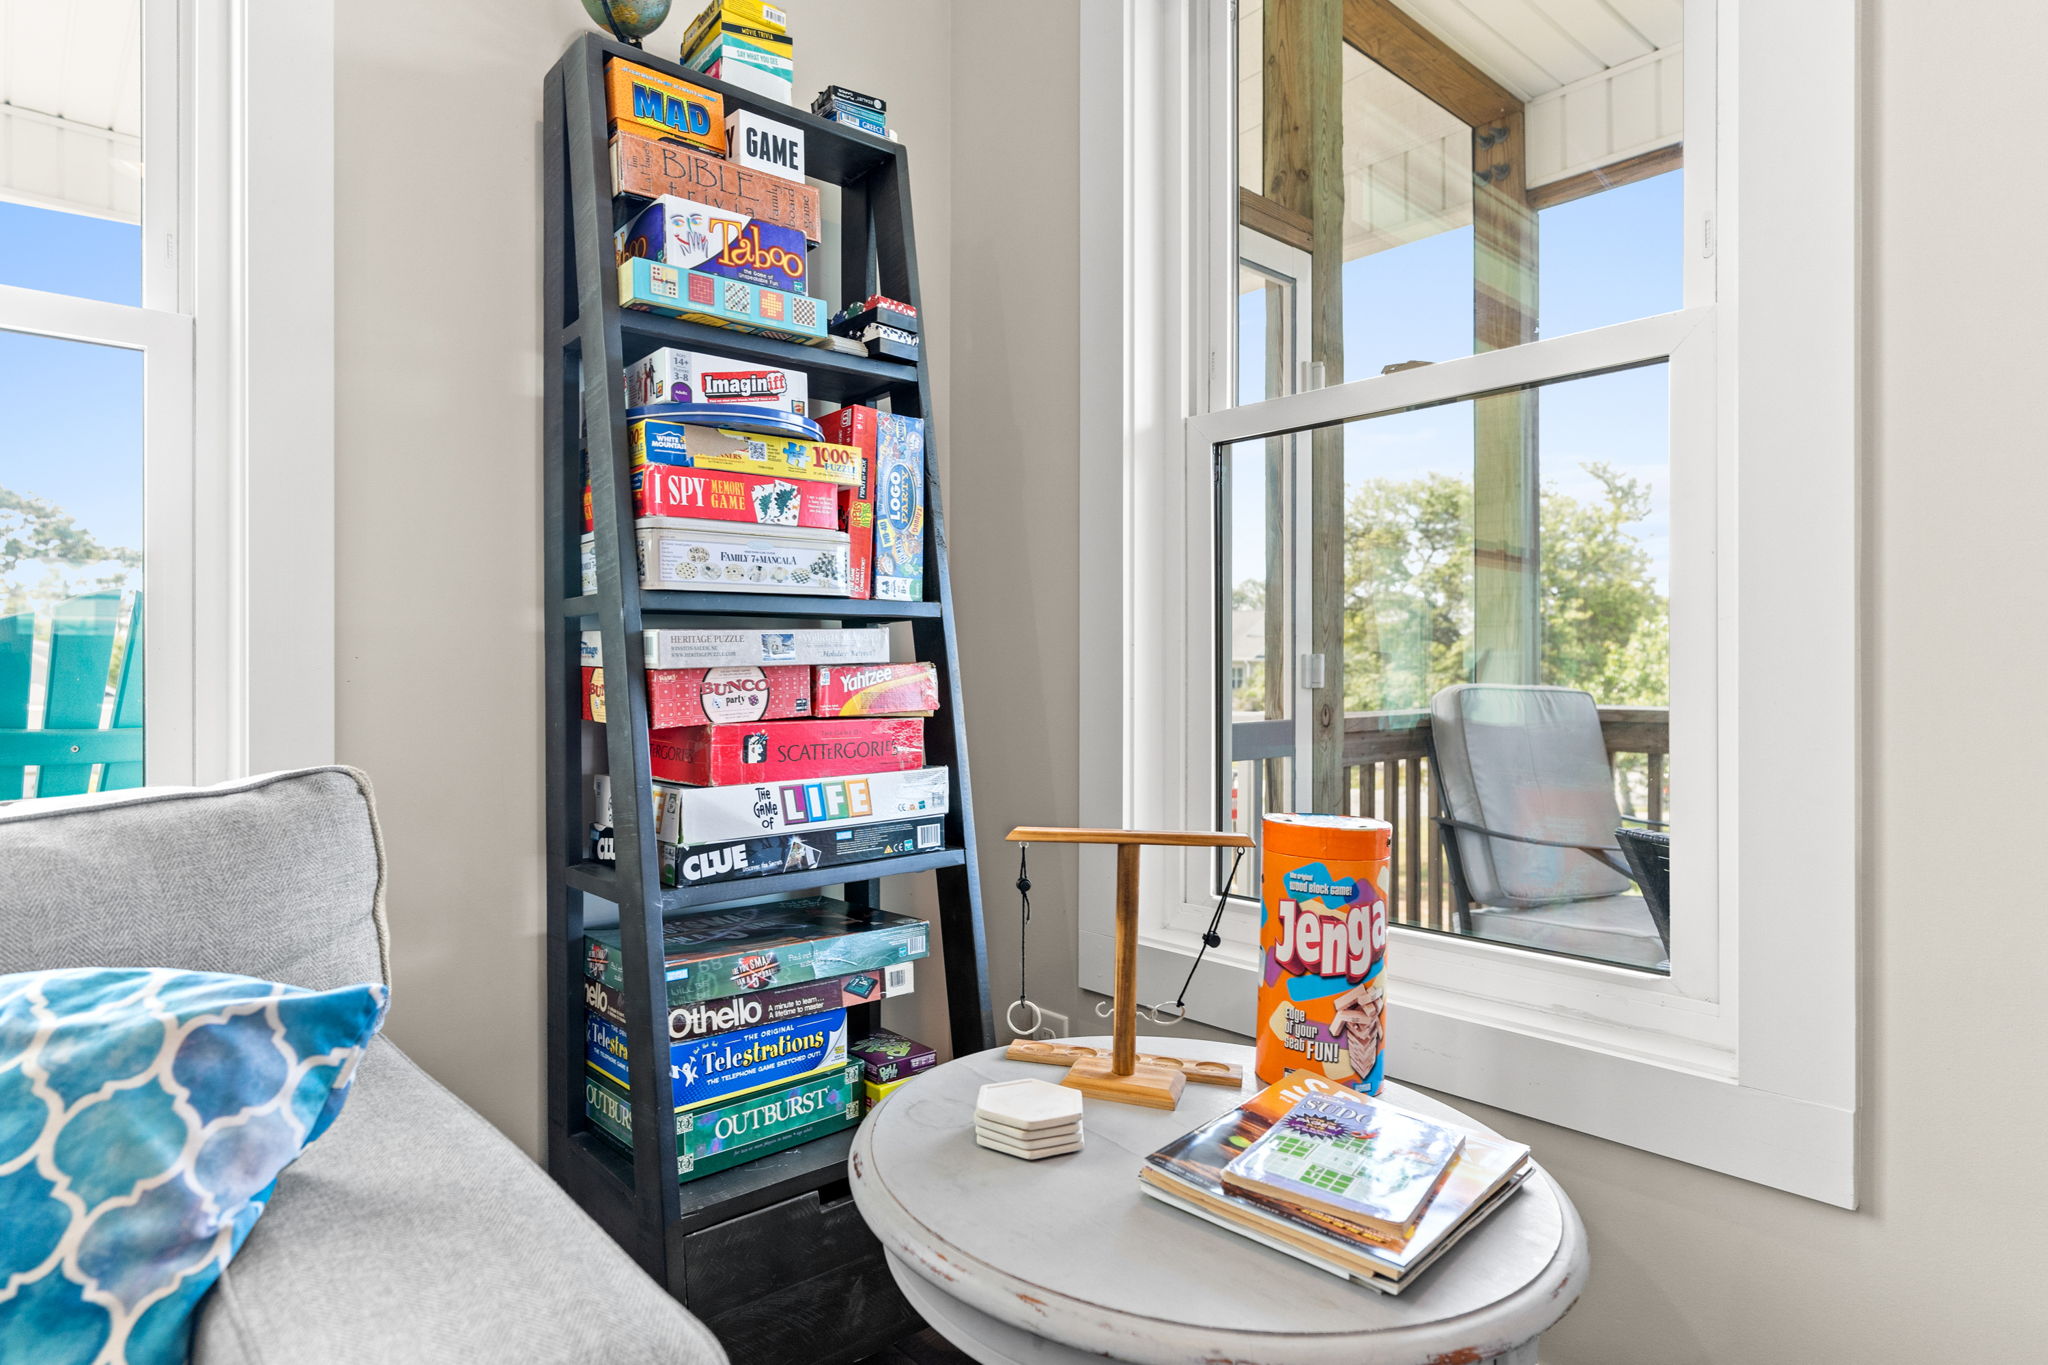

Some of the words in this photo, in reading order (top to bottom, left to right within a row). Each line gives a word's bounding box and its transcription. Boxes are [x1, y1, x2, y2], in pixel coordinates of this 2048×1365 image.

[758, 30, 774, 40] TRIVIA
[737, 49, 746, 58] SAY
[746, 51, 760, 60] WHAT
[760, 54, 769, 63] YOU
[632, 81, 711, 136] MAD
[746, 127, 799, 171] GAME
[662, 148, 760, 202] BIBLE
[766, 183, 780, 222] family
[783, 187, 797, 230] board
[802, 195, 816, 232] game
[708, 217, 805, 279] Taboo
[673, 357, 689, 367] 14+
[673, 372, 689, 382] 3-8
[704, 372, 787, 397] Imaginiff
[656, 434, 680, 444] WHITE
[813, 446, 850, 468] 1000
[654, 472, 663, 504] I
[668, 475, 705, 507] SPY
[711, 480, 745, 496] MEMORY
[889, 471, 901, 520] LOGO
[901, 470, 909, 524] PARTY
[711, 494, 746, 511] GAME
[879, 520, 891, 545] WD-40
[720, 551, 749, 563] FAMILY
[670, 635, 713, 644] HERITAGE
[714, 634, 745, 643] PUZZLE
[700, 678, 770, 696] BUNCO
[840, 668, 893, 693] Yahtzee
[725, 694, 746, 706] party
[777, 740, 899, 763] SCATTERGORIES
[781, 780, 870, 823] LIFE
[682, 843, 749, 881] CLUE
[1289, 881, 1308, 893] wood
[1296, 873, 1314, 882] original
[1275, 899, 1386, 977] Jenga
[668, 997, 763, 1040] Othello
[768, 1004, 774, 1013] A
[774, 1000, 795, 1011] minute
[795, 999, 802, 1007] to
[769, 1011, 775, 1020] A
[775, 1006, 797, 1018] lifetime
[797, 1005, 804, 1014] to
[804, 1002, 825, 1013] master
[1285, 1008, 1306, 1023] Edge
[743, 1032, 759, 1041] THE
[760, 1024, 795, 1037] ORIGINAL
[1285, 1021, 1295, 1034] of
[1295, 1023, 1318, 1039] your
[701, 1030, 825, 1075] Telestrations
[1284, 1036, 1306, 1052] seat
[1306, 1040, 1340, 1063] FUN!
[706, 1077, 720, 1086] THE
[721, 1068, 758, 1082] TELEPHONE
[757, 1063, 776, 1073] GAME
[776, 1054, 807, 1069] SKETCHED
[807, 1050, 823, 1061] OUT!
[714, 1087, 829, 1140] OUTBURST
